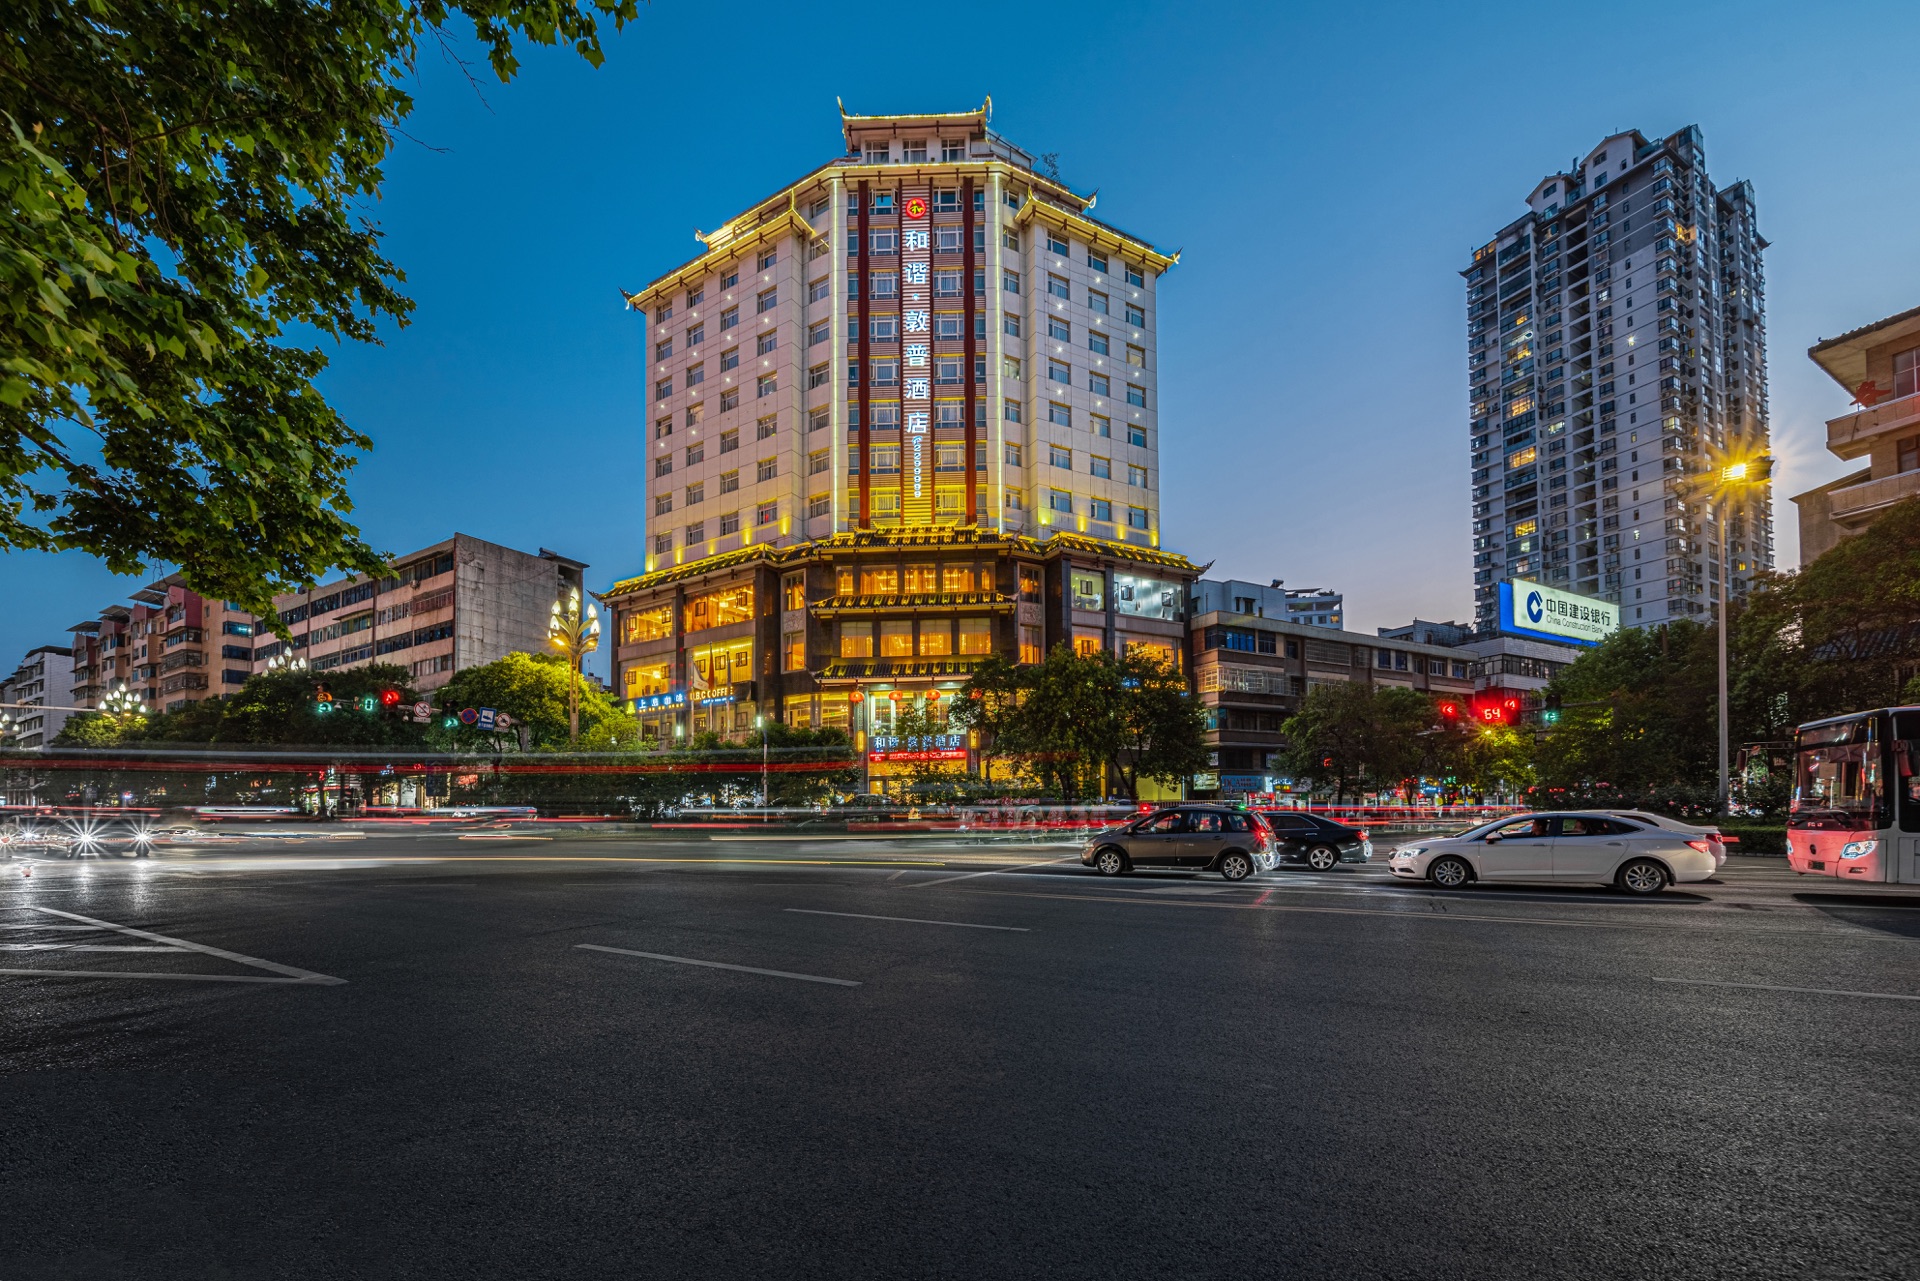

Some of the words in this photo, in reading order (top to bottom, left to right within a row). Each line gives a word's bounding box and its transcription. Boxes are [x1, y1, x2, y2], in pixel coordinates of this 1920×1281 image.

[905, 230, 928, 433] 和谐·敦普酒店
[1546, 598, 1610, 626] 中国建设银行
[1547, 614, 1561, 625] China
[1562, 618, 1590, 632] Construction
[1592, 624, 1604, 634] Bank
